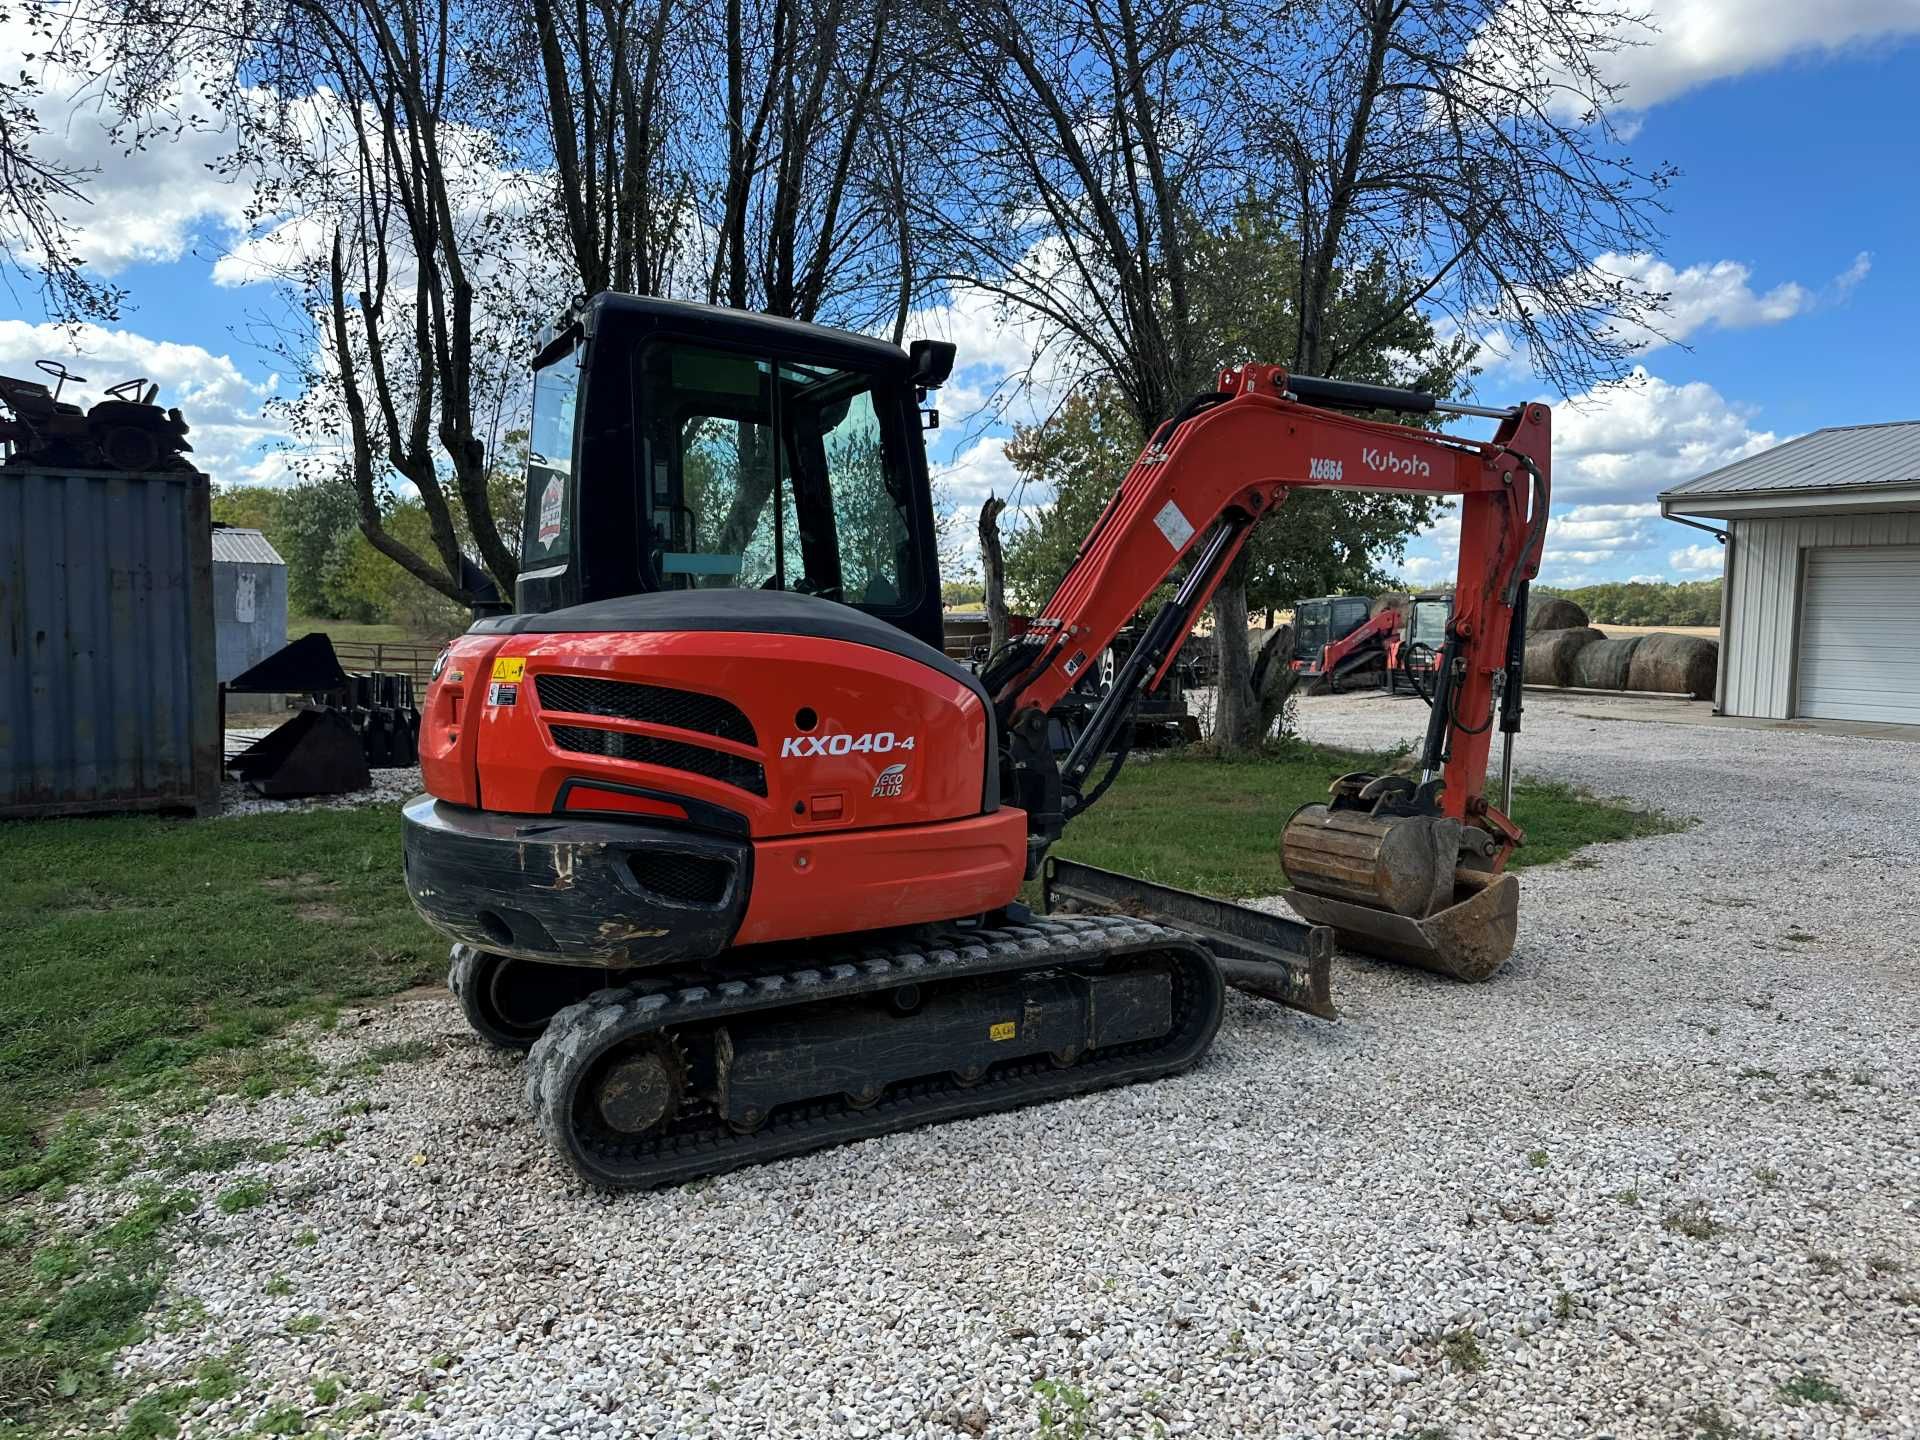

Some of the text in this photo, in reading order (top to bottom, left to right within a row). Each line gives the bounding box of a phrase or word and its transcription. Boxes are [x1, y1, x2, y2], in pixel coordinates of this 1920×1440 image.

[1310, 457, 1343, 480] X6856
[1362, 447, 1430, 477] Kubota
[781, 732, 915, 758] KX040-4
[871, 784, 902, 798] PLUS
[880, 774, 904, 786] eco
